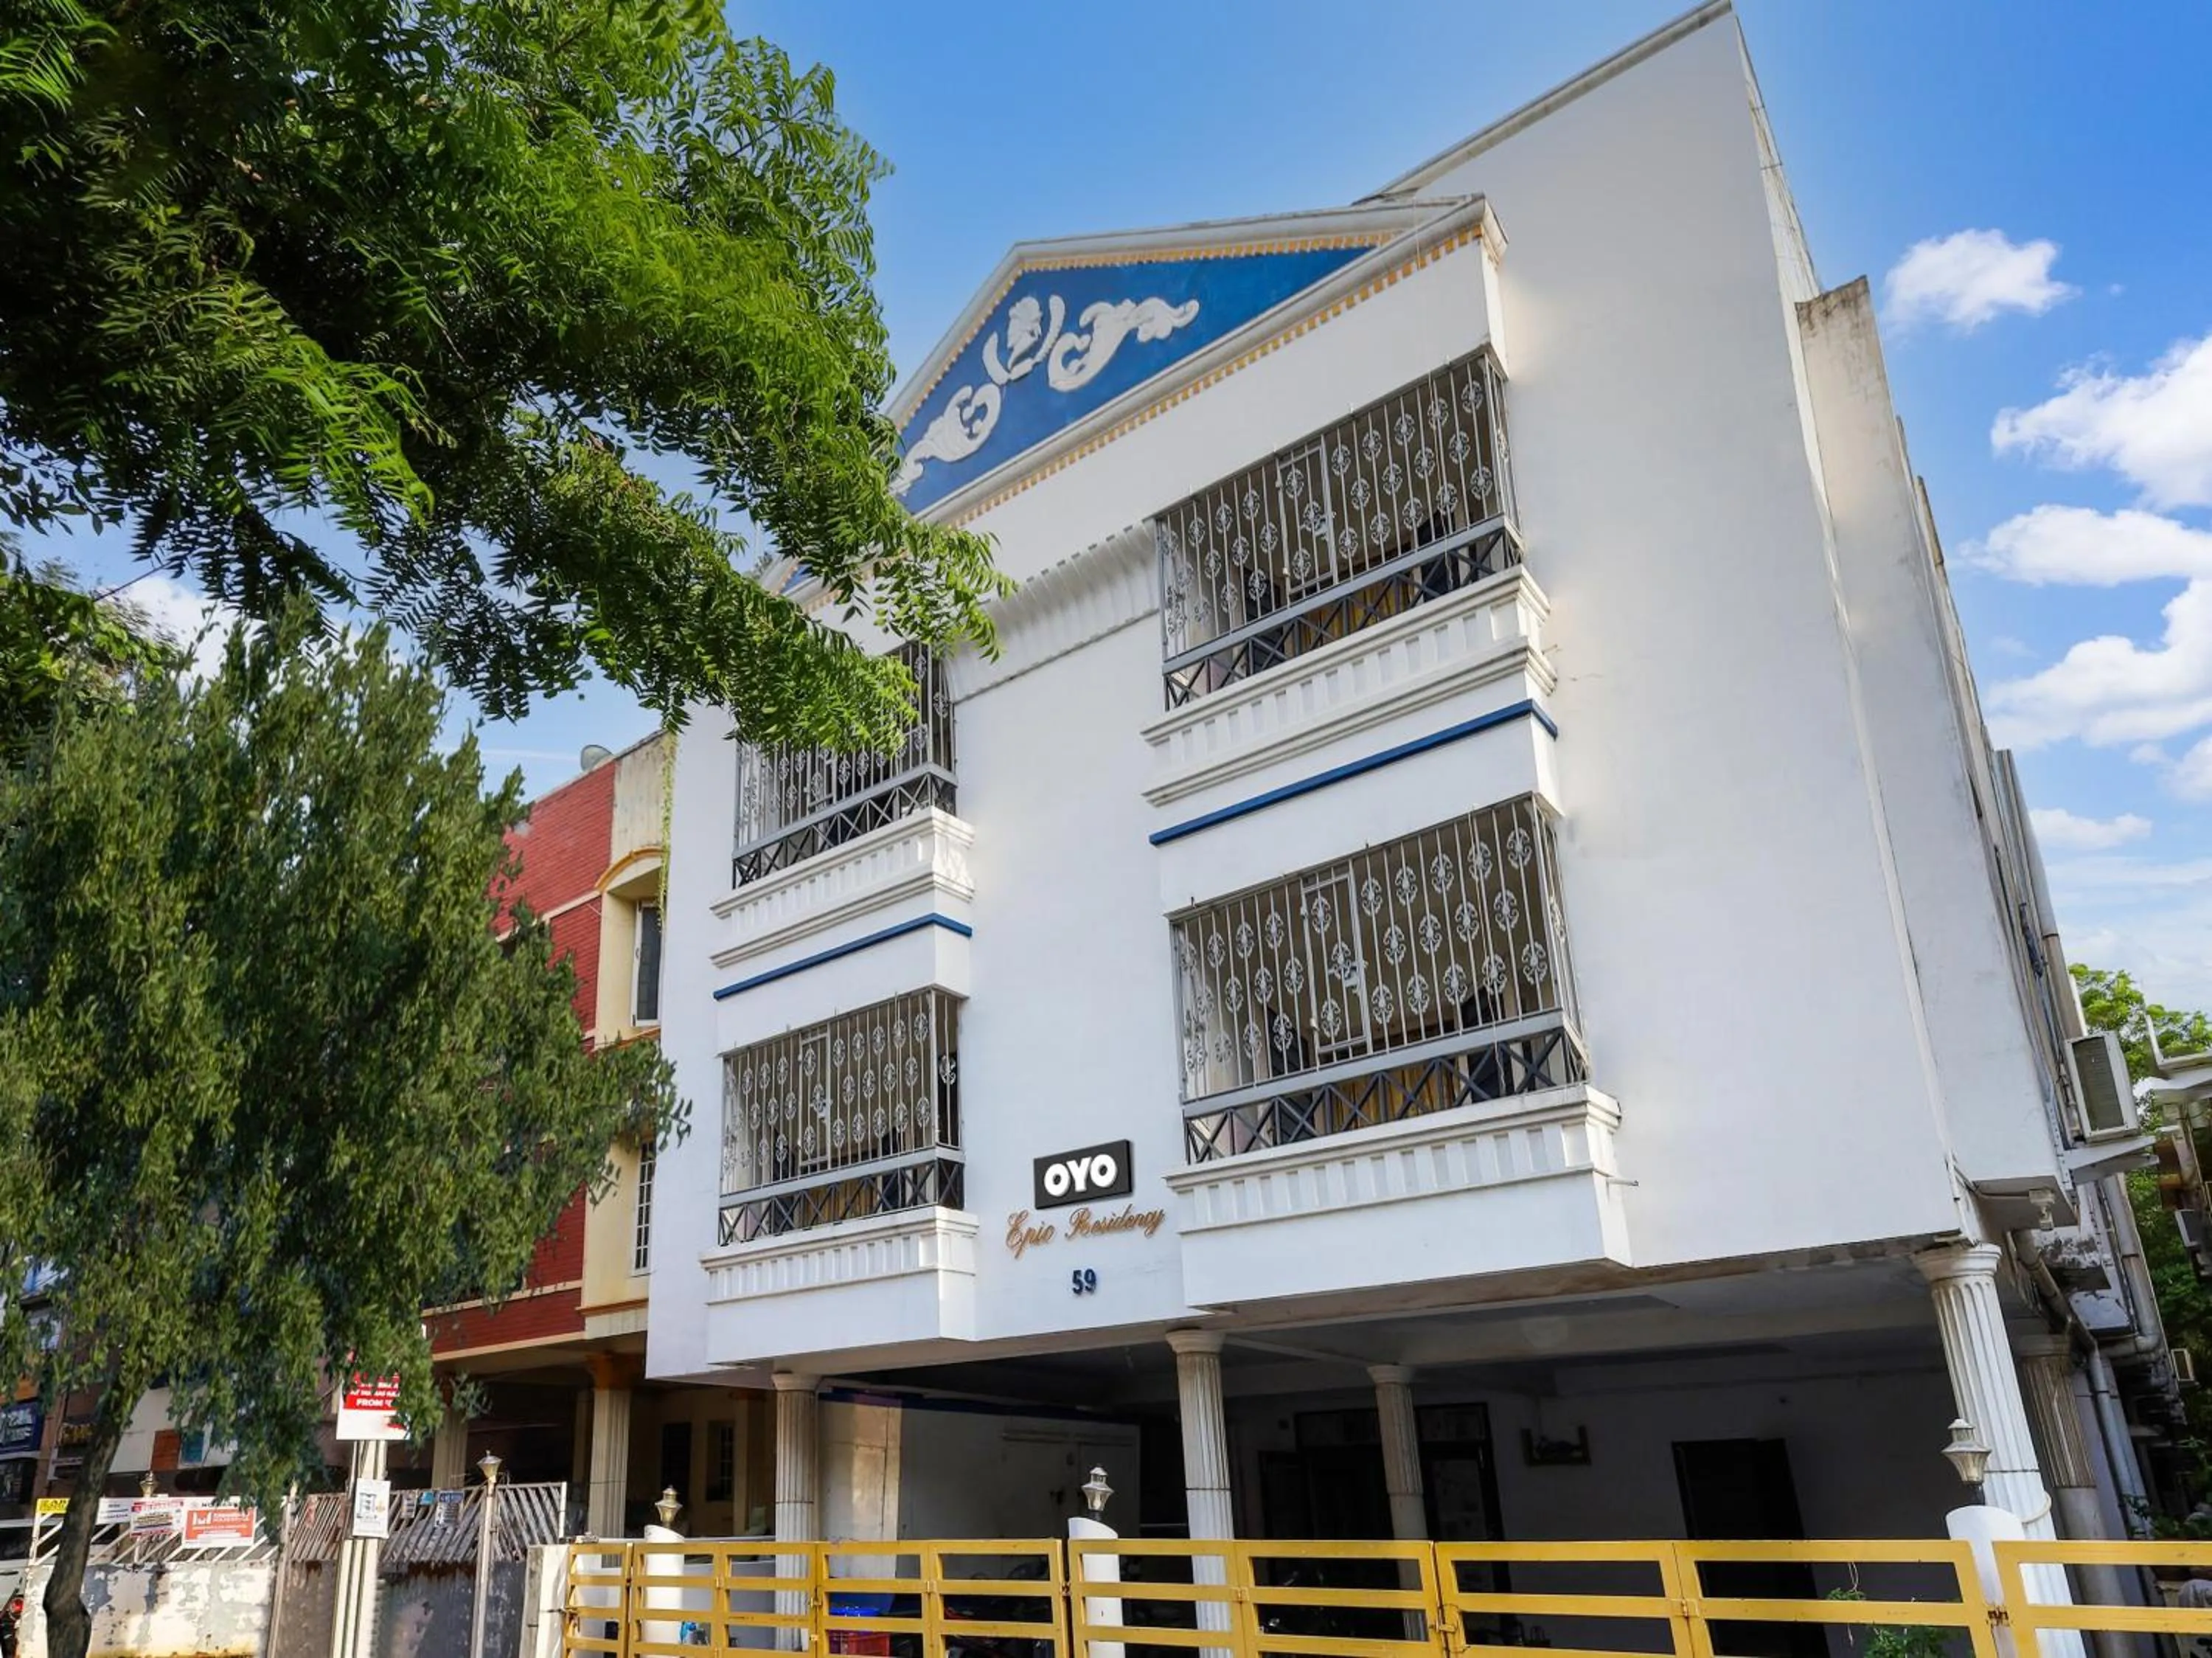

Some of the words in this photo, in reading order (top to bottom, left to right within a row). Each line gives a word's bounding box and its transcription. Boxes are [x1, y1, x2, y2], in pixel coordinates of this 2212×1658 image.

[1043, 1154, 1118, 1196] OYO
[1006, 1209, 1055, 1259] Epic
[1065, 1204, 1166, 1238] Residency
[1072, 1268, 1097, 1295] 59
